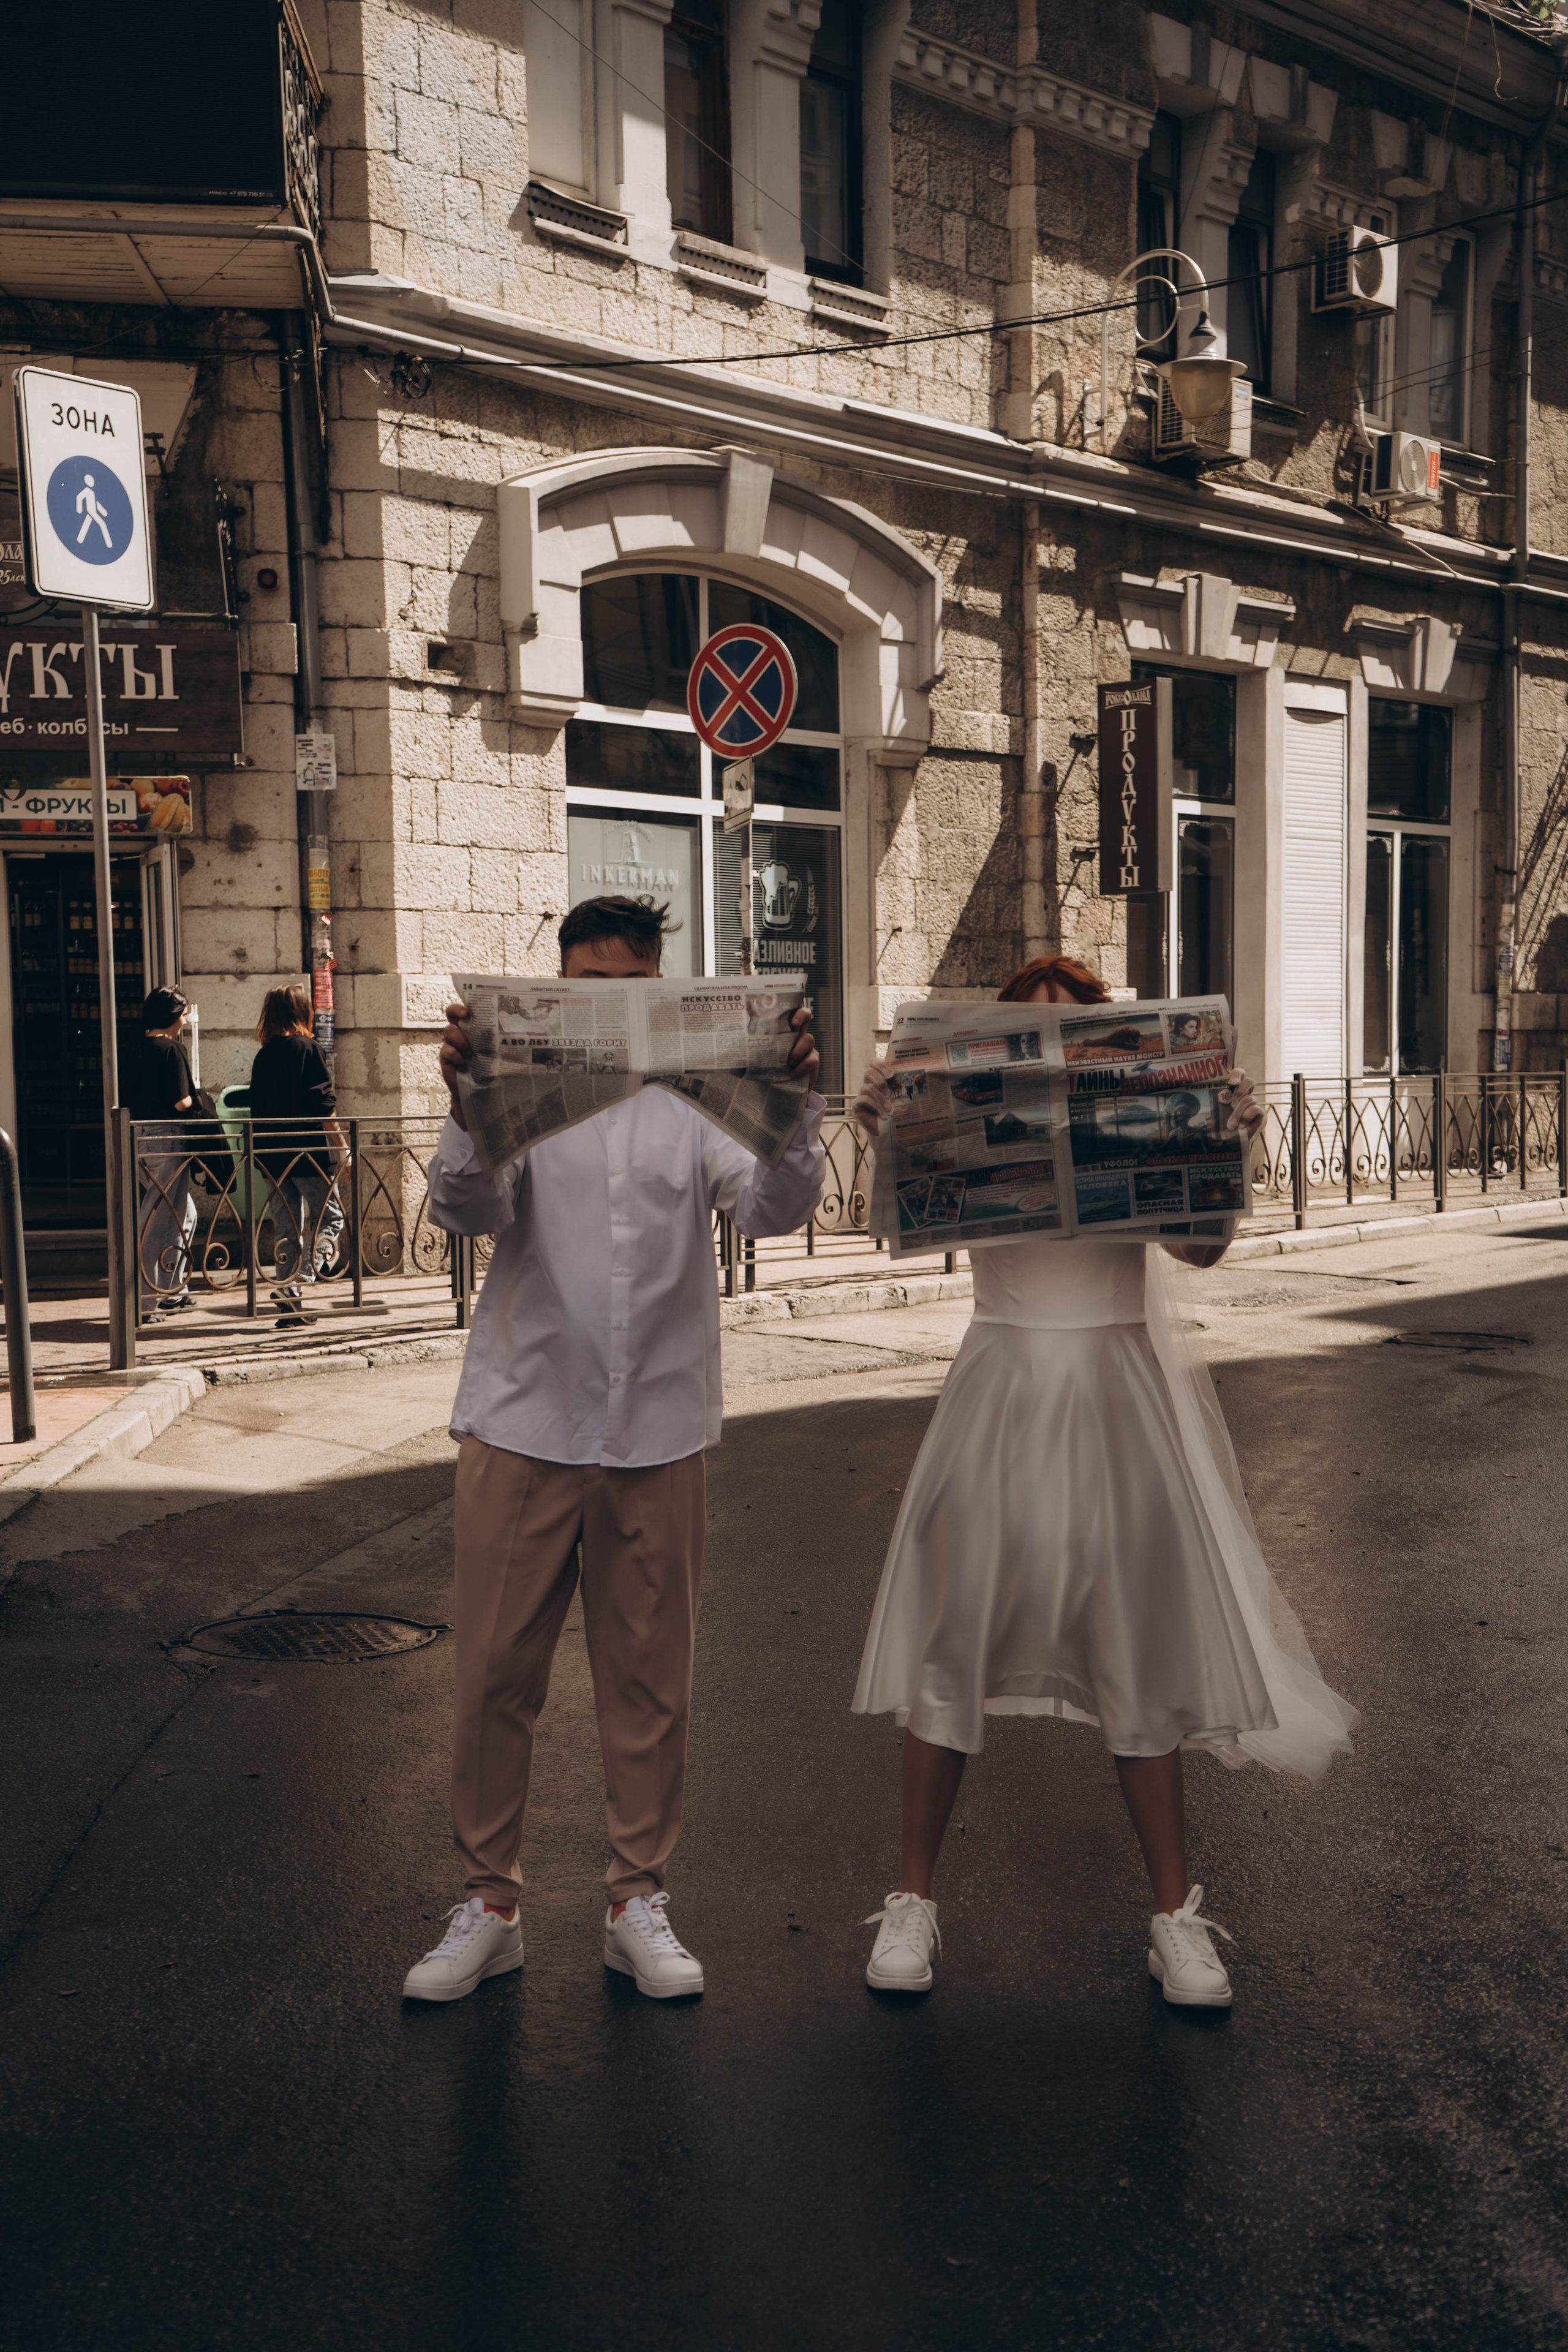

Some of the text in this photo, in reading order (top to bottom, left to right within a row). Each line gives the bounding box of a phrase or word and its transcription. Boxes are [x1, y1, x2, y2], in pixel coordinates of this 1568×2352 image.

[51, 402, 115, 437] ЗОНА
[37, 718, 129, 735] колбсы
[1118, 708, 1141, 888] ПРОДУКТЫ
[26, 796, 127, 814] ФРУКЫ
[581, 863, 679, 886] INKERMAN
[753, 940, 816, 964] АЗЛИВНОЕ
[680, 1003, 744, 1012] ПРОДАВАТЬ
[552, 1038, 592, 1047] ЗВЕЗДА
[594, 1038, 627, 1047] ГОРИТ
[1066, 1057, 1113, 1066] НЕИЗВЕСТНЫЙ
[1136, 1051, 1164, 1060] МОНСТР
[1066, 1068, 1125, 1093] ТАЙНЫ
[1104, 1158, 1139, 1168] УФОЛОГ
[1189, 1165, 1241, 1174] ИСКУССТВО
[1189, 1171, 1242, 1180] ПРОДАВАТЬ
[1076, 1180, 1127, 1191] ЧЕЛОВЕКА
[1136, 1199, 1184, 1208] ОПАСНАЯ
[1137, 1206, 1185, 1215] ПОПУТЧИЦА
